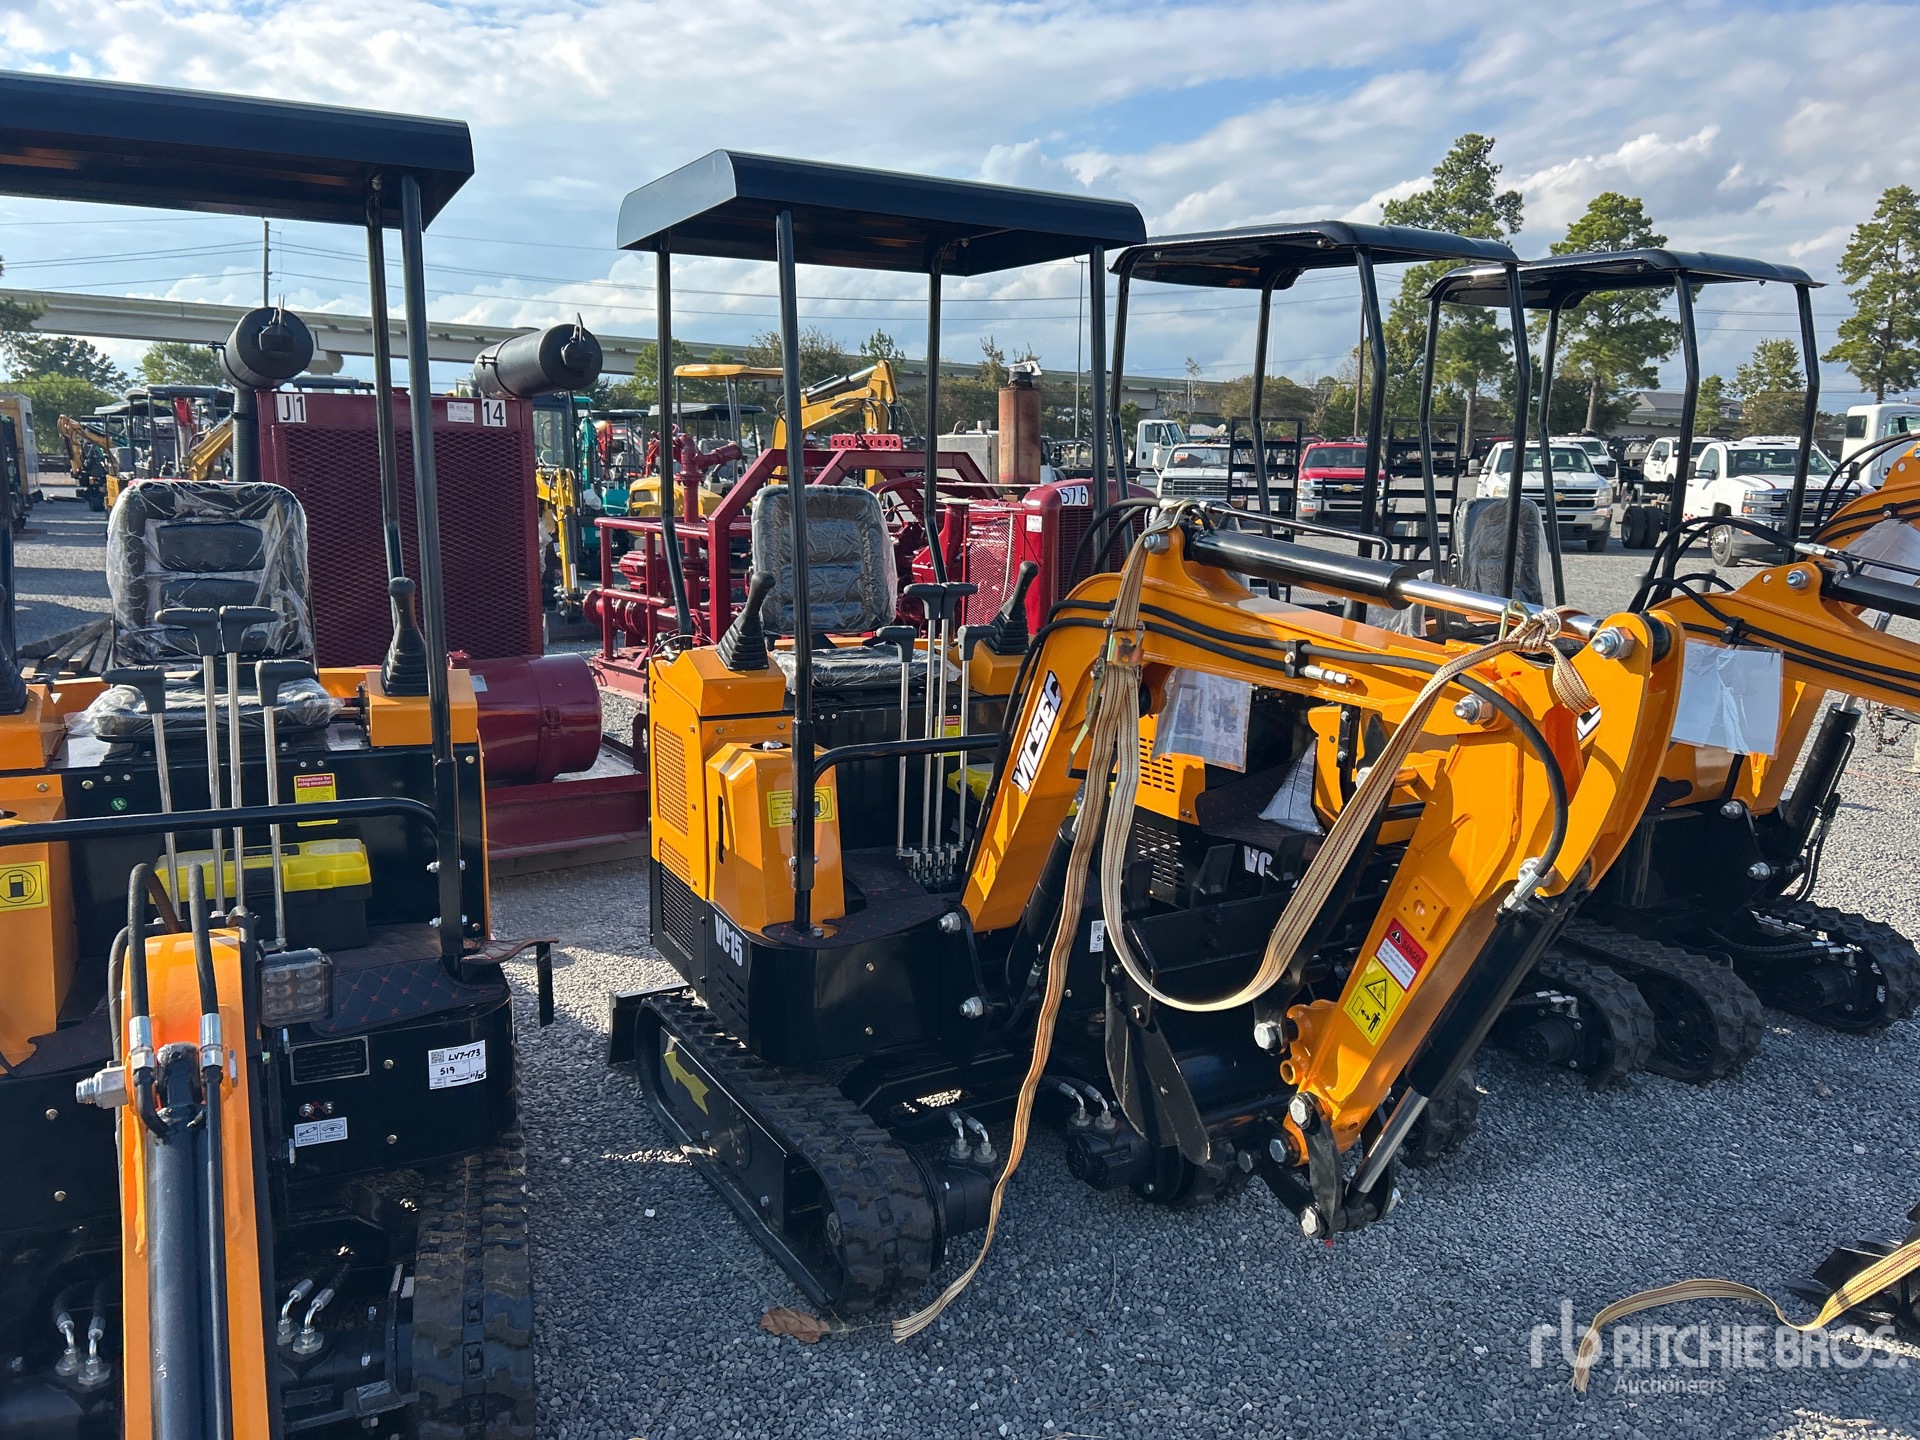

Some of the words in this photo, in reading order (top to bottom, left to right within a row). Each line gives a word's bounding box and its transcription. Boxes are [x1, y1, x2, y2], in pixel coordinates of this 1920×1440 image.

[483, 401, 505, 426] 14
[1060, 487, 1087, 505] 576
[714, 913, 743, 967] VC15
[1402, 940, 1422, 964] DANGER
[440, 1066, 455, 1075] 519
